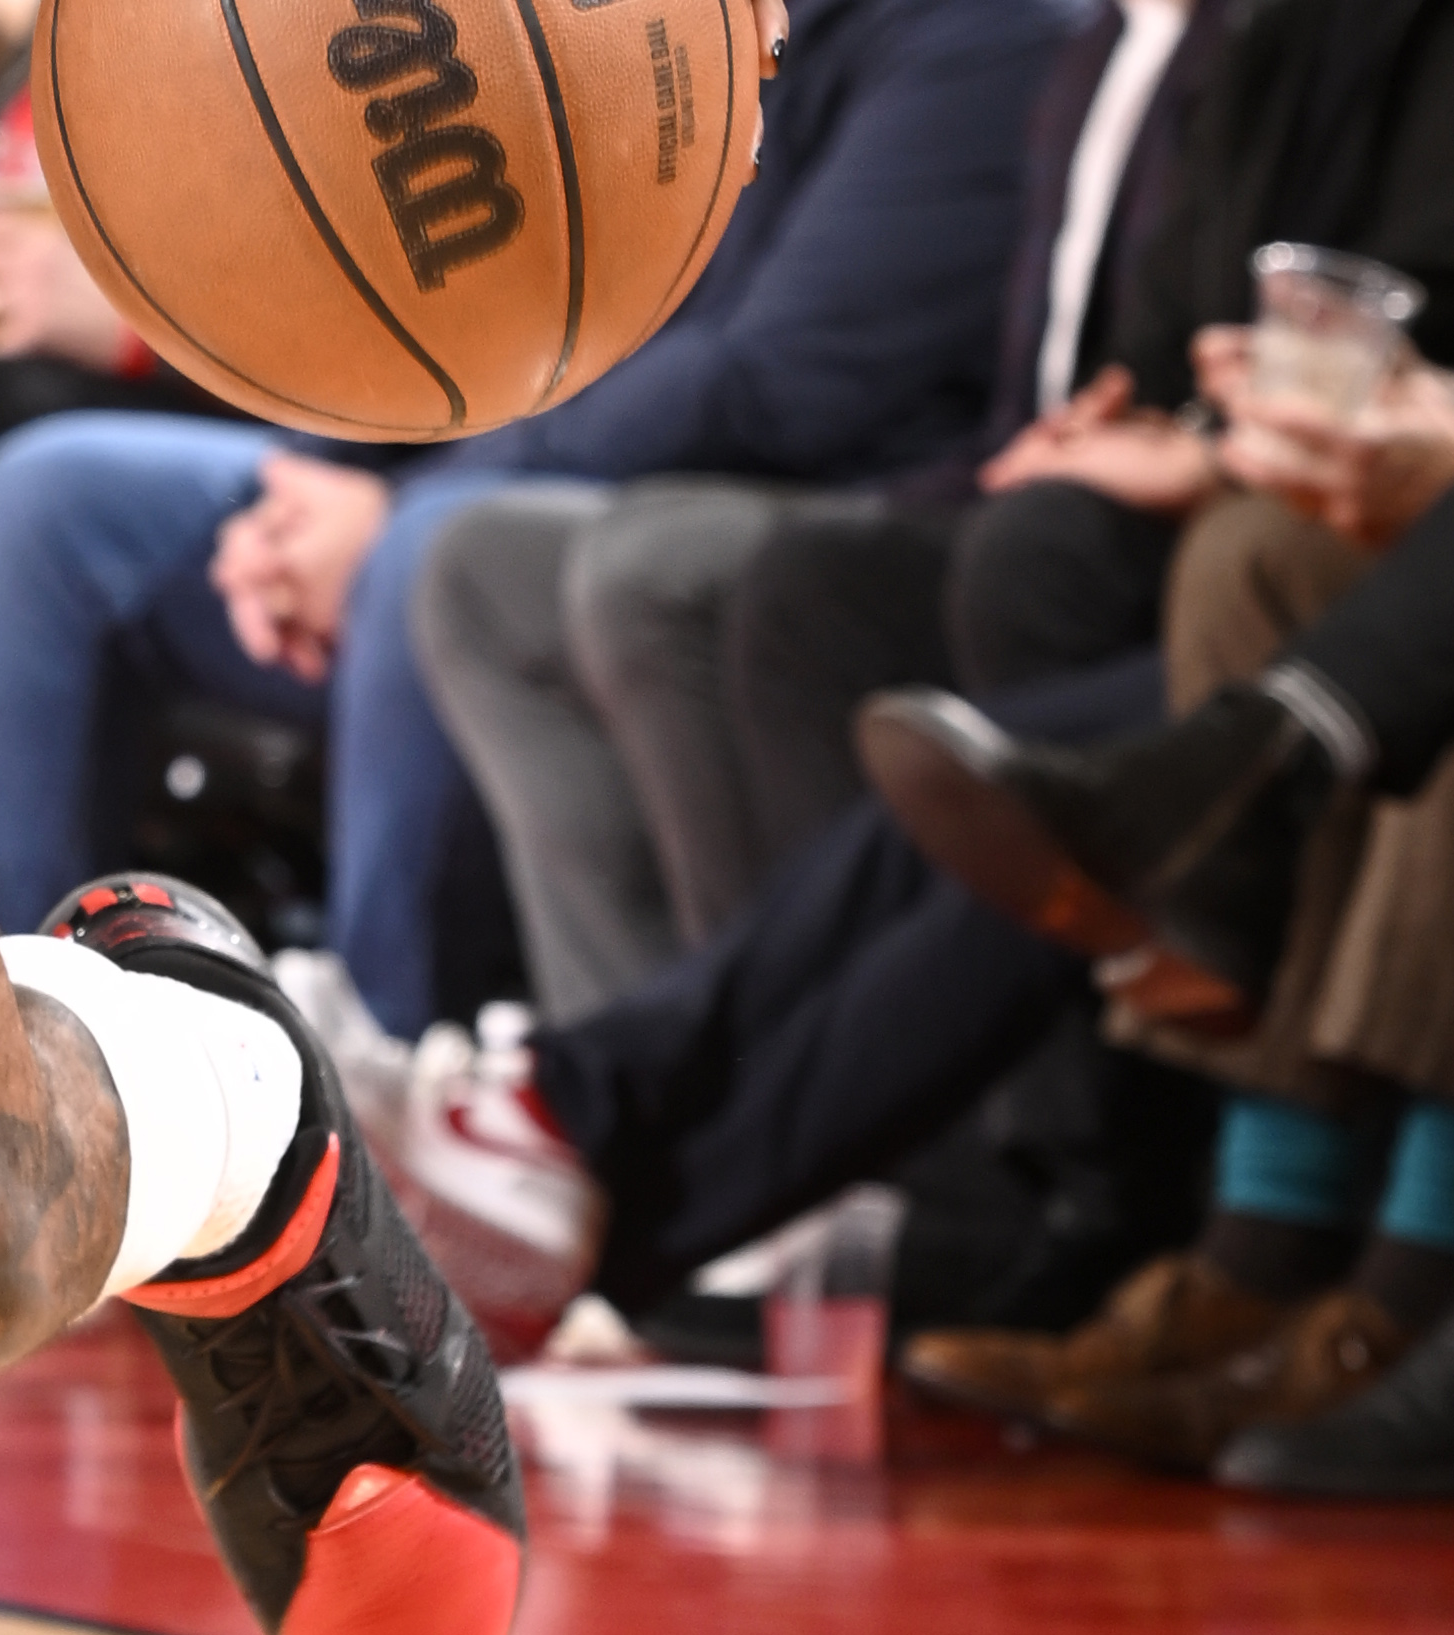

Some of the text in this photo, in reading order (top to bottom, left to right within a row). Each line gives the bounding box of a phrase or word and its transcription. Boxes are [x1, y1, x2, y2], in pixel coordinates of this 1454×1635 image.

[645, 17, 678, 185] OFFICIAL GAME BALL
